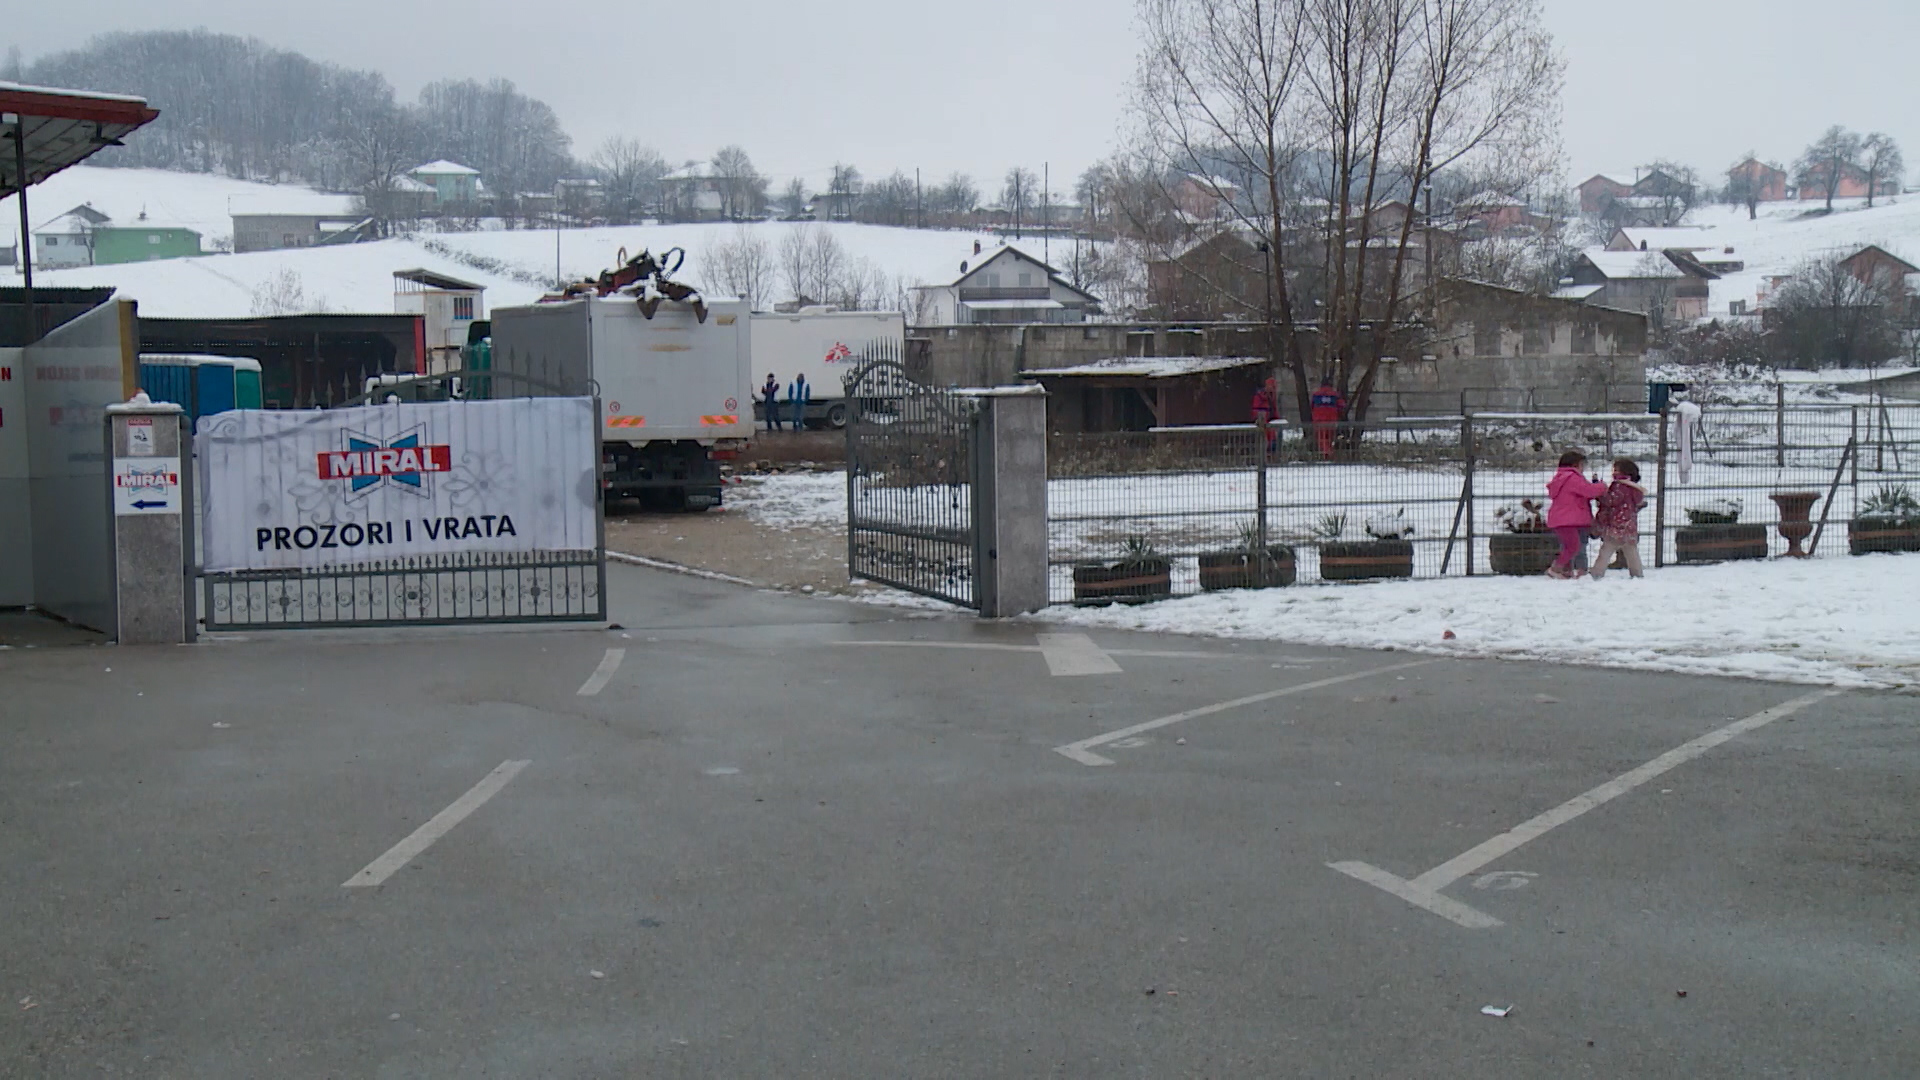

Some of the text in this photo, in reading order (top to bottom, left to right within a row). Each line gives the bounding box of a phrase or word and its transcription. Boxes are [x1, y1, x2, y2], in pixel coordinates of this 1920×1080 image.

[329, 449, 440, 478] MIRAL
[120, 474, 175, 487] MIRAL
[257, 515, 517, 551] PROZORI I VRATA
